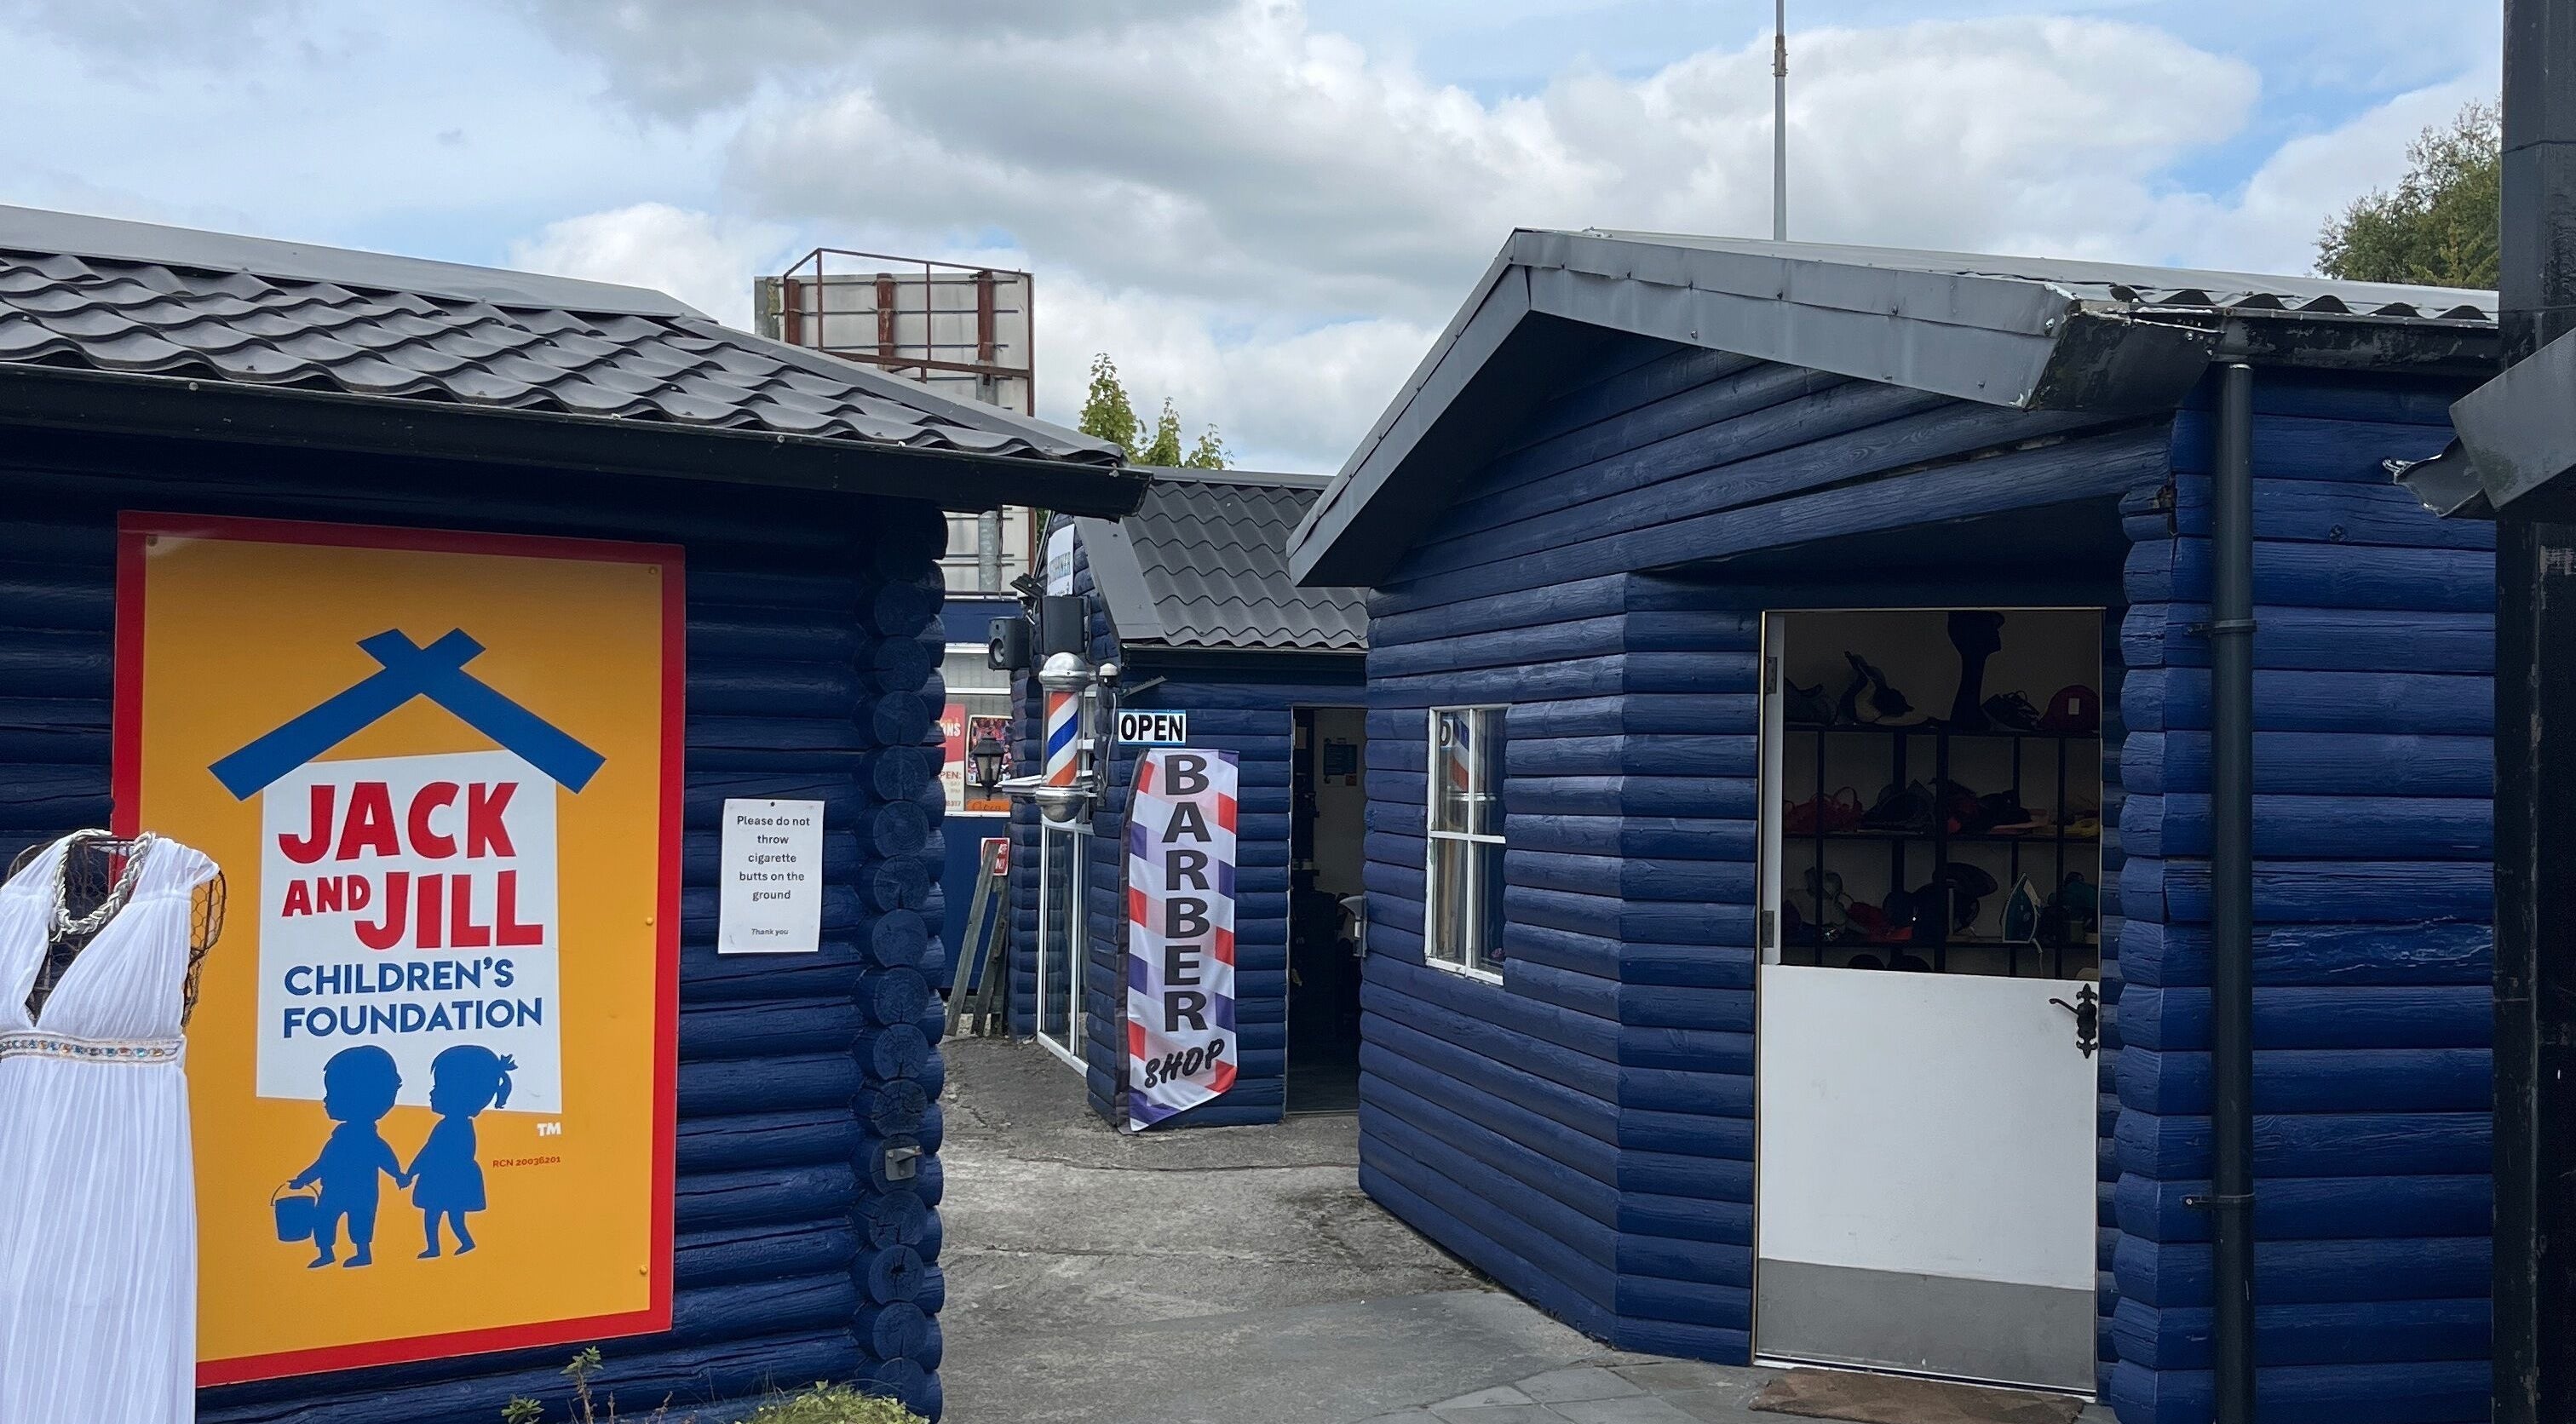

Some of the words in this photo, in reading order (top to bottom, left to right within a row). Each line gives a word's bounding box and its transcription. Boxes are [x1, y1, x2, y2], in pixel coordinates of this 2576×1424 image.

[1120, 714, 1183, 742] OPEN
[940, 771, 962, 779] PEN:
[278, 781, 519, 864] JACK
[737, 815, 773, 826] Please
[776, 816, 790, 826] do
[792, 817, 810, 826] not
[757, 835, 790, 844] throw
[748, 853, 796, 864] cigarette
[739, 871, 768, 881] butts
[786, 871, 805, 881] the
[752, 890, 791, 902] ground
[1162, 754, 1212, 1032] BARBER
[282, 874, 371, 917] AND
[354, 870, 543, 950] JILL
[284, 956, 515, 996] CHILDREN'S
[284, 997, 543, 1038] FOUNDATION
[1144, 1038, 1225, 1089] SHOP
[537, 1122, 561, 1137] TM
[492, 1159, 514, 1168] RCN
[515, 1156, 561, 1167] 20036201
